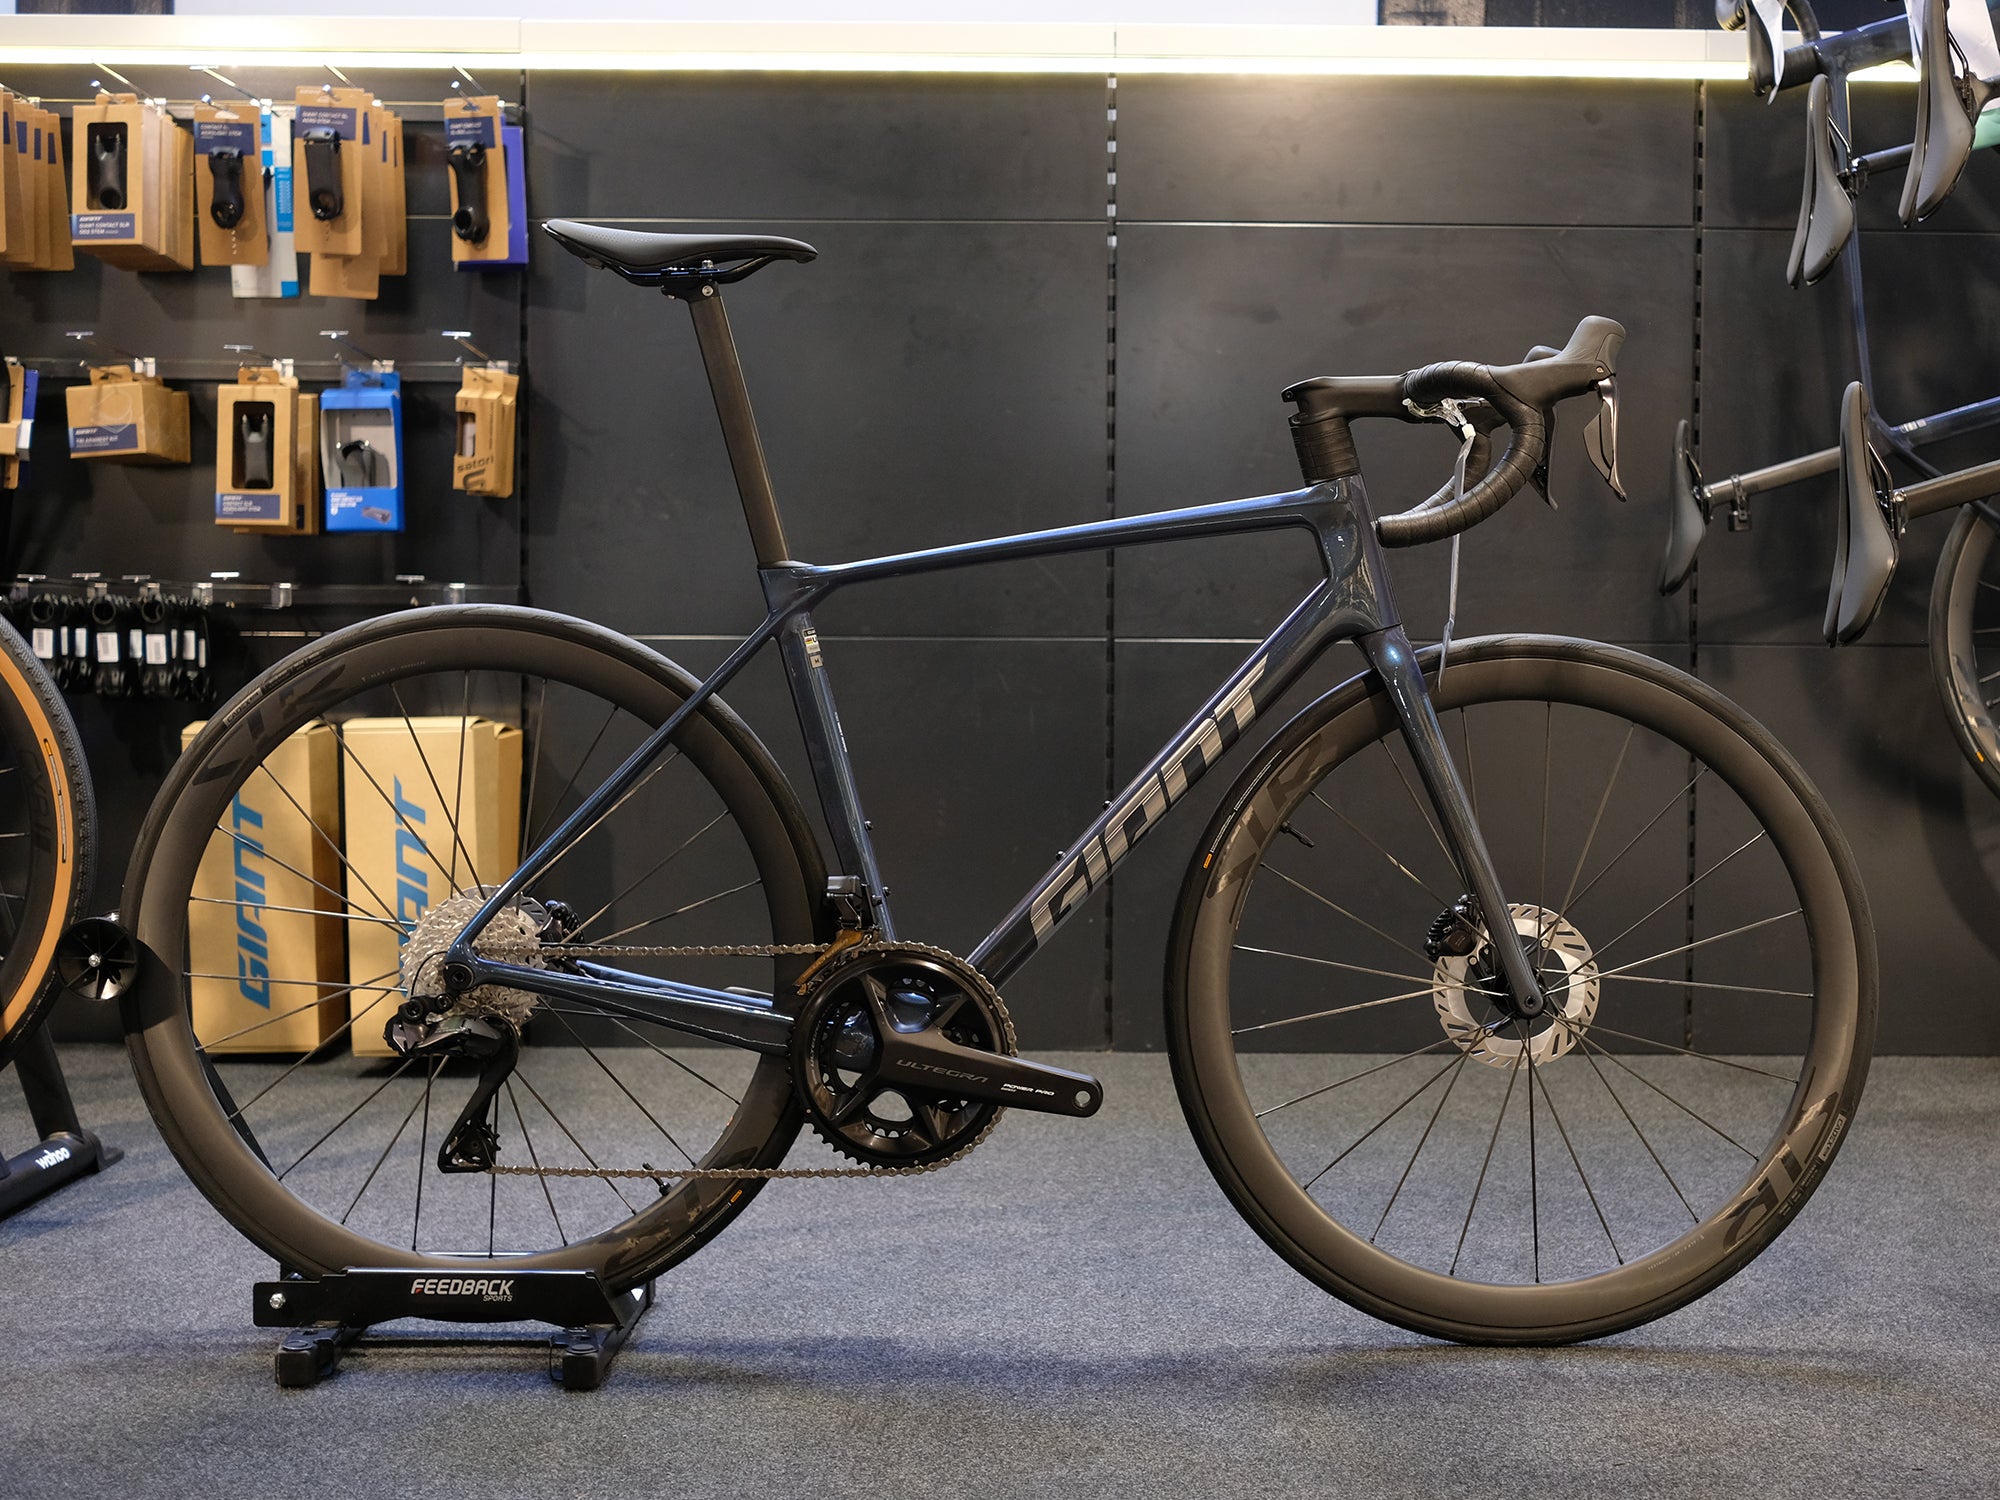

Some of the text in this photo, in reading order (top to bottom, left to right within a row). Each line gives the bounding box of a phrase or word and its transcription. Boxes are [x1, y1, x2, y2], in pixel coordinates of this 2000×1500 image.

[457, 455, 494, 474] satori
[232, 788, 271, 1010] GIANT
[896, 1059, 989, 1083] ULTEGRA
[1002, 1083, 1034, 1092] POWER
[34, 1147, 71, 1170] wahoo
[411, 1279, 515, 1295] FEEDBACK
[482, 1294, 513, 1302] SPORTS
